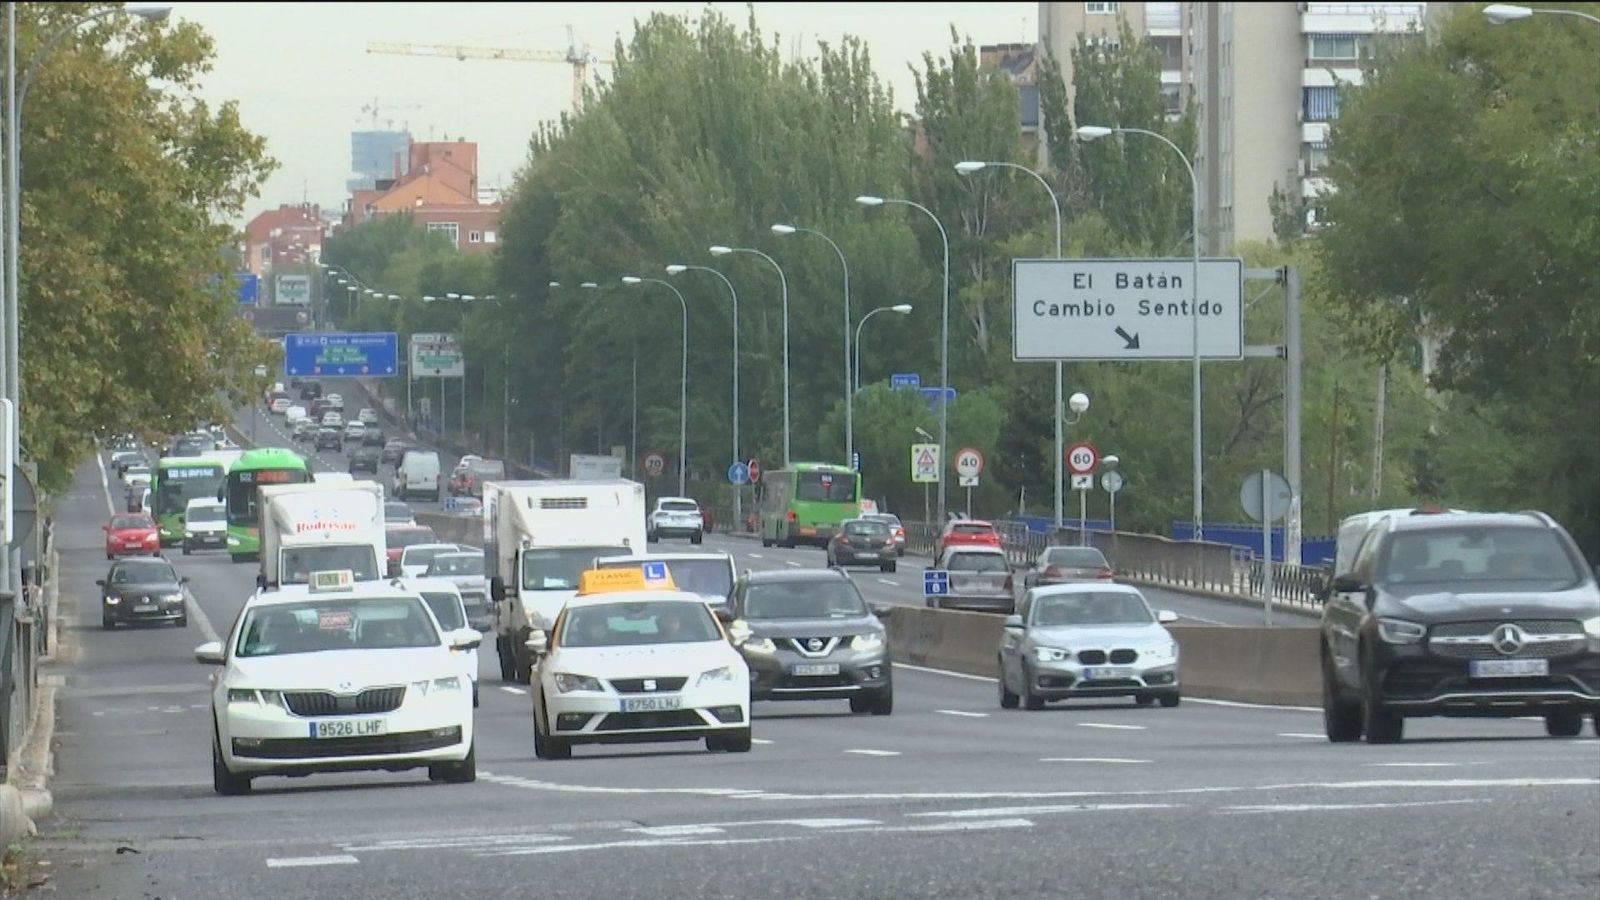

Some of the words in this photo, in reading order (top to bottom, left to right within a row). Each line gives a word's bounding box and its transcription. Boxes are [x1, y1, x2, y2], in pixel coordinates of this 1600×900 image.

[1073, 272, 1093, 289] El
[1115, 271, 1183, 289] Batán
[1033, 299, 1116, 316] Cambio
[1138, 299, 1223, 316] Sentido
[961, 458, 977, 467] 40
[1073, 454, 1091, 464] 60
[647, 565, 661, 577] L
[628, 699, 656, 711] 8750
[658, 697, 681, 709] LHJ
[319, 721, 353, 736] 9526
[357, 720, 382, 735] LHF
